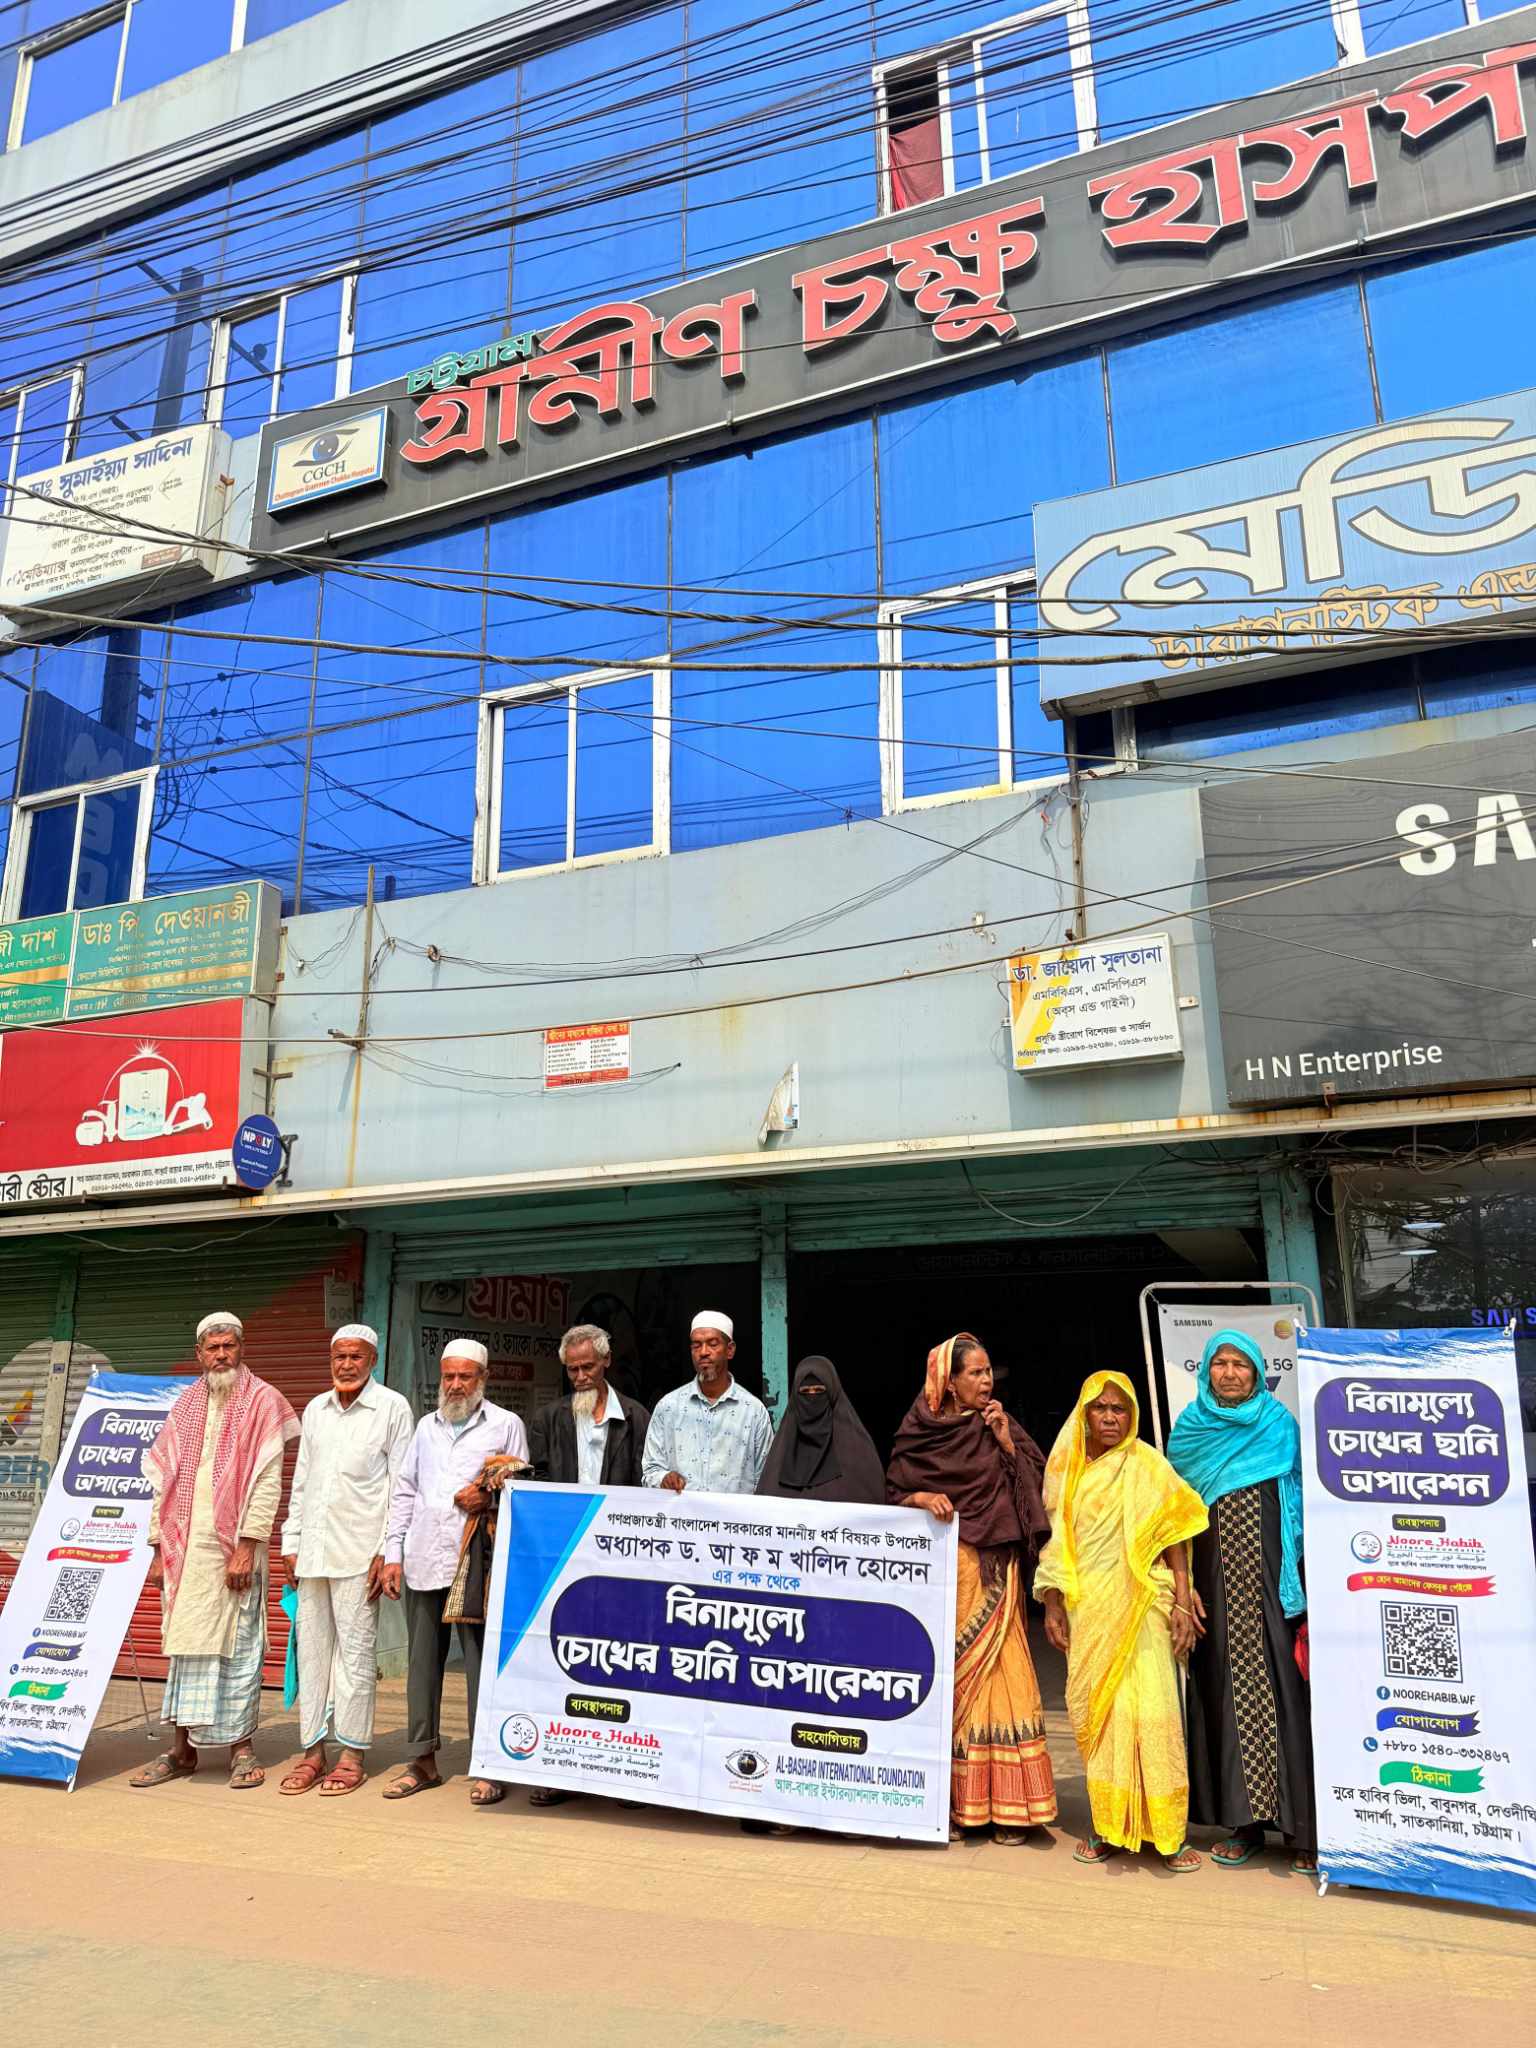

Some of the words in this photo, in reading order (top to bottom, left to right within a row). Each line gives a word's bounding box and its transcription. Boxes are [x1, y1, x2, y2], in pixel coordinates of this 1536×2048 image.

[400, 290, 756, 466] গ্রামীণ
[792, 196, 1045, 347] চক্ষু
[406, 329, 536, 394] চট্টগ্রাম
[302, 460, 346, 484] CGCH
[1101, 945, 1164, 973] সুলতানা
[1245, 1059, 1266, 1081] H
[1272, 1055, 1292, 1078] N
[1299, 1042, 1443, 1076] Enterprise
[1345, 1382, 1475, 1424] বিনামূল্যে
[79, 1445, 138, 1467] চোখের
[1327, 1429, 1423, 1458] চোখের
[1432, 1424, 1499, 1459] ছানি
[1340, 1468, 1490, 1500] অপারেশন
[670, 1517, 720, 1533] বাংলাদেশ
[723, 1521, 772, 1537] সরকারের
[776, 1524, 816, 1541] মাননীয়
[820, 1527, 838, 1543] ধর্ম
[842, 1527, 882, 1545] বিষয়ক
[885, 1532, 932, 1551] উপদেষ্টা
[594, 1534, 673, 1559] অধ্যাপক
[709, 1542, 735, 1566] আ
[740, 1546, 761, 1568] ফ
[766, 1548, 783, 1570] ম
[790, 1546, 851, 1577] খালিদ
[856, 1556, 932, 1584] হোসেন
[712, 1569, 733, 1584] এর
[737, 1570, 762, 1587] পক্ষ
[766, 1574, 801, 1591] থেকে
[665, 1585, 806, 1647] বিনামূল্যে
[556, 1635, 660, 1675] চোখের
[669, 1640, 740, 1684] ছানি
[749, 1655, 923, 1704] অপারেশন
[1393, 1689, 1476, 1705] NOOREHABIB.WF
[545, 1721, 602, 1740] Noore
[1395, 1714, 1461, 1731] যোগাযোগ
[776, 1755, 817, 1777] AL-BASHAR
[818, 1761, 876, 1785] INTERNATIONAL
[877, 1767, 926, 1789] FOUNDATION
[1411, 1762, 1453, 1786] ঠিকানা
[1332, 1786, 1354, 1801] নুরে
[1357, 1786, 1390, 1804] হাবিব
[1400, 1813, 1469, 1837] সাতকানিয়া,
